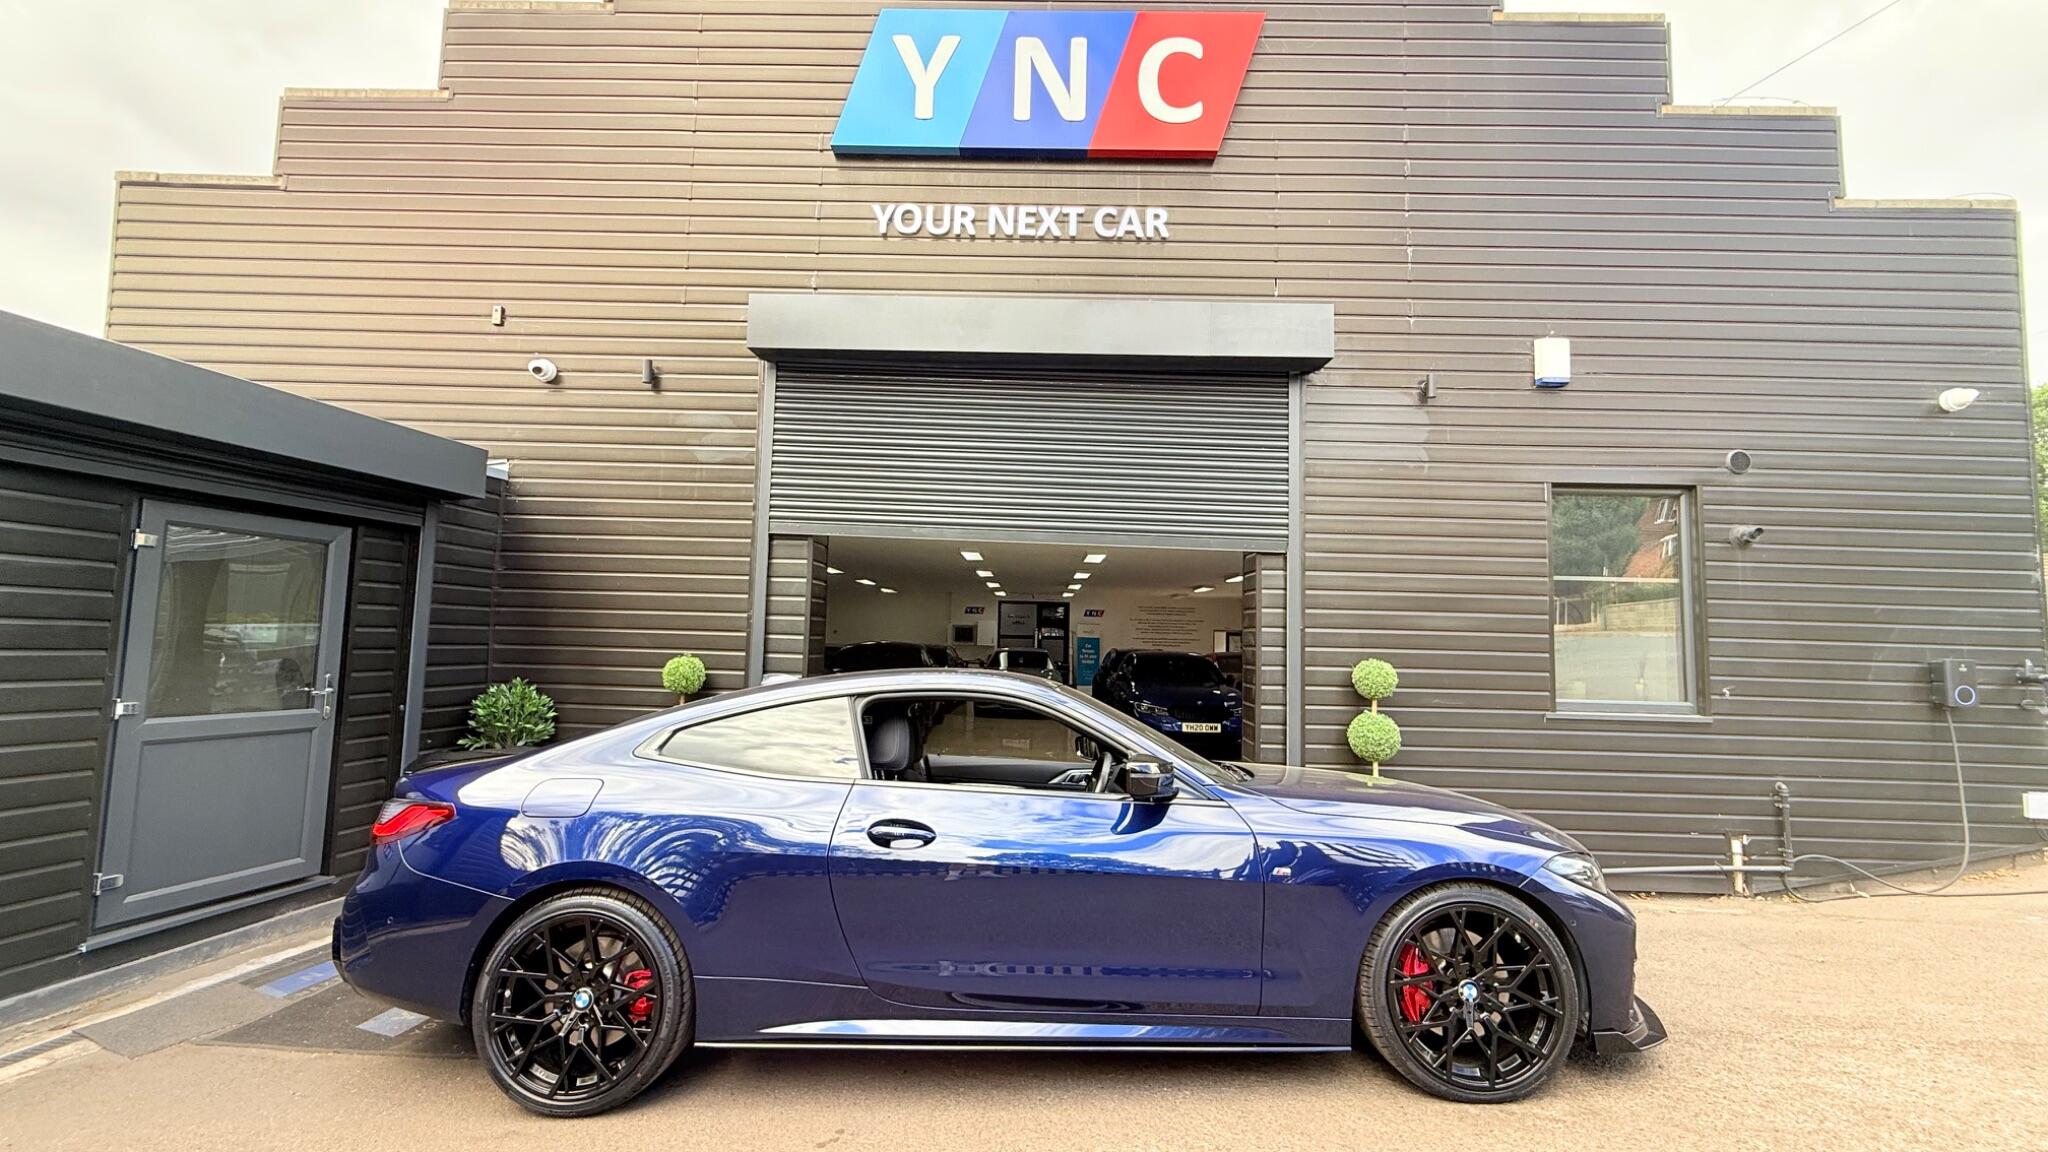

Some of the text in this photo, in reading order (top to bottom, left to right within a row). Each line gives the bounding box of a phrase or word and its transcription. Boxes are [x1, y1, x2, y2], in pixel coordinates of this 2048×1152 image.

[892, 35, 1203, 123] YNC
[872, 203, 1170, 239] YOUR NEXT CAR
